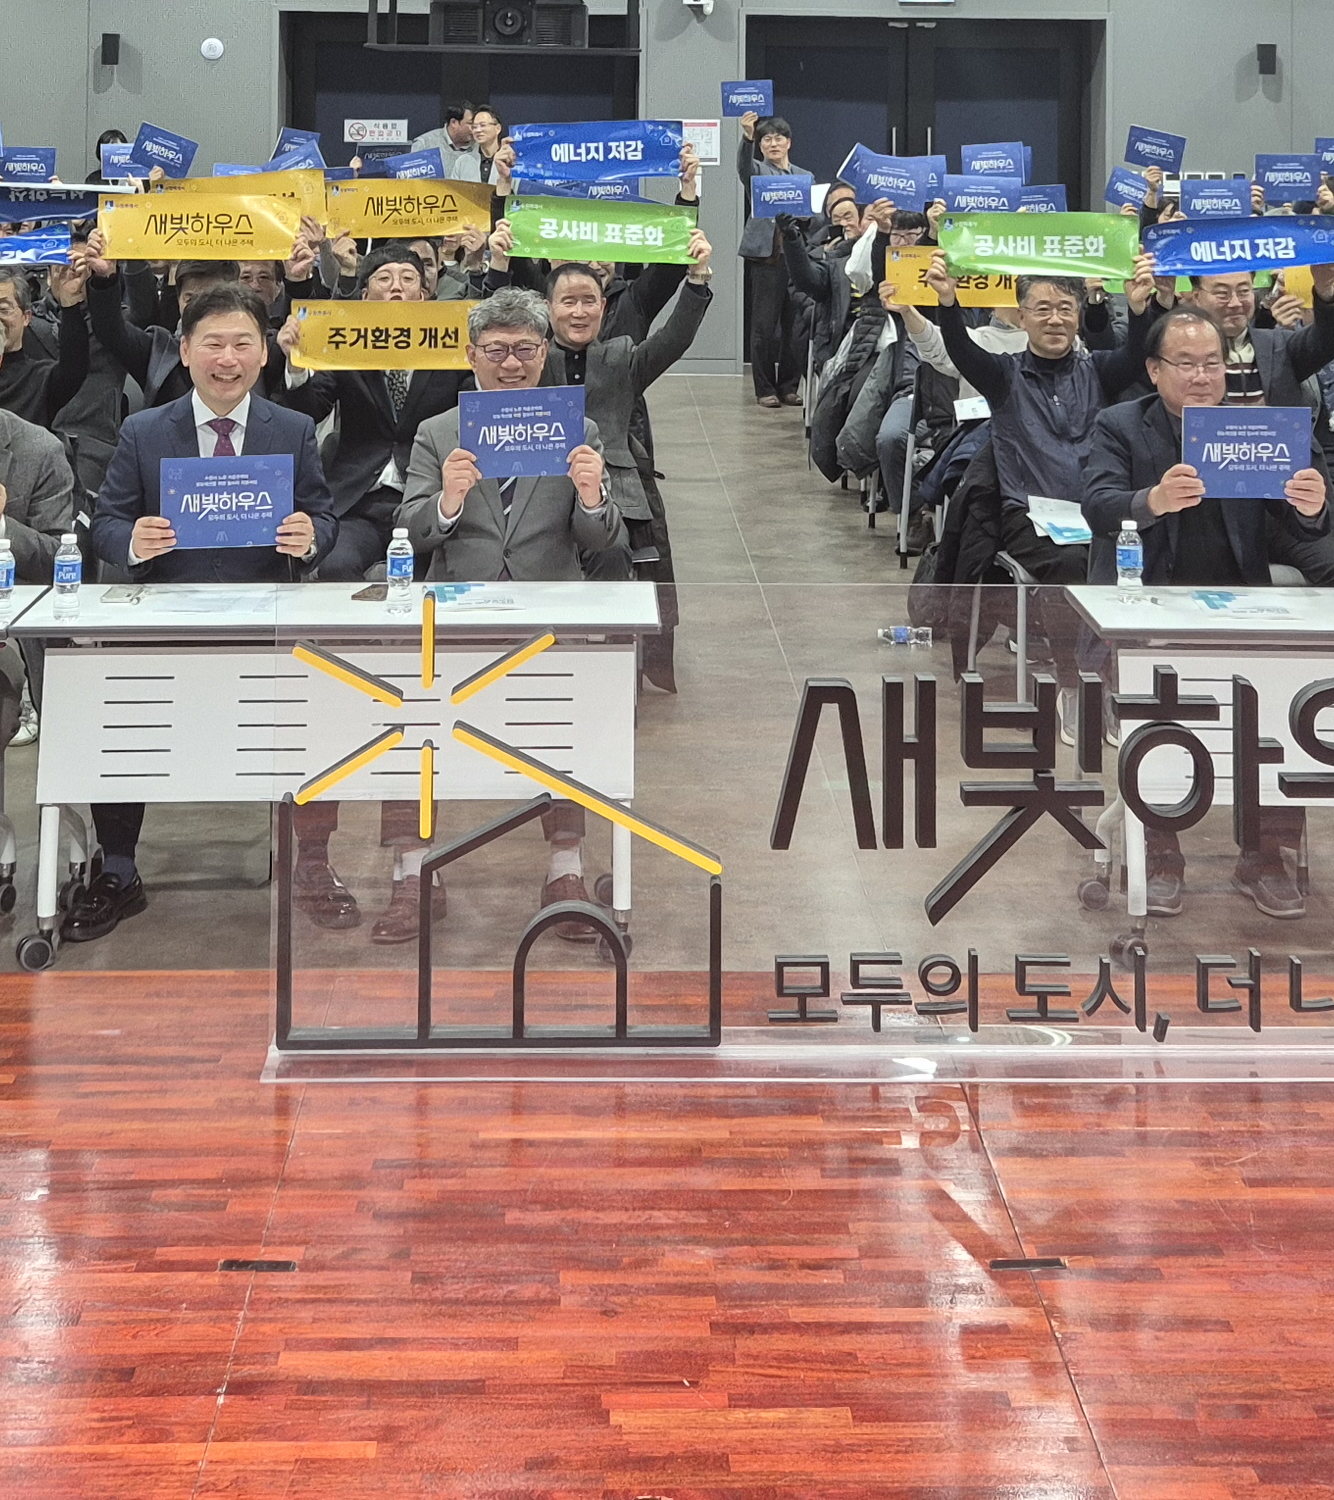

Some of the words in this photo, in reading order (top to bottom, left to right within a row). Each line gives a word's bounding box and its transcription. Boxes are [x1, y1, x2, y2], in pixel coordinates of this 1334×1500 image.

[142, 140, 183, 163] 새빛하우스
[551, 142, 604, 163] 에너지
[608, 140, 644, 161] 저감
[1134, 141, 1175, 159] 새빛하우스
[971, 159, 1015, 173] 새빛하우스
[866, 173, 916, 192] 새빛하우스
[1265, 171, 1312, 186] 새빛하우스
[761, 190, 803, 204] 새빛하우스
[954, 195, 1009, 211] 새빛하우스
[1191, 197, 1242, 214] 새빛하우스
[364, 194, 458, 224] 새빛하우스
[144, 212, 254, 244] 새빛하우스
[539, 217, 598, 242] 공사비
[603, 223, 665, 246] 표준화
[973, 235, 1035, 257] 공사비
[1042, 235, 1106, 258] 표준화
[1190, 239, 1252, 263] 에너지
[1255, 236, 1296, 260] 저감
[327, 326, 411, 349] 주거환경
[418, 327, 459, 349] 개선
[478, 422, 566, 452] 새빛하우스
[1202, 442, 1291, 470] 새빛하우스
[180, 491, 273, 520] 새빛하우스
[767, 947, 979, 1033] 모두의
[1006, 946, 1171, 1043] 도시,
[1196, 947, 1262, 1033] 더
